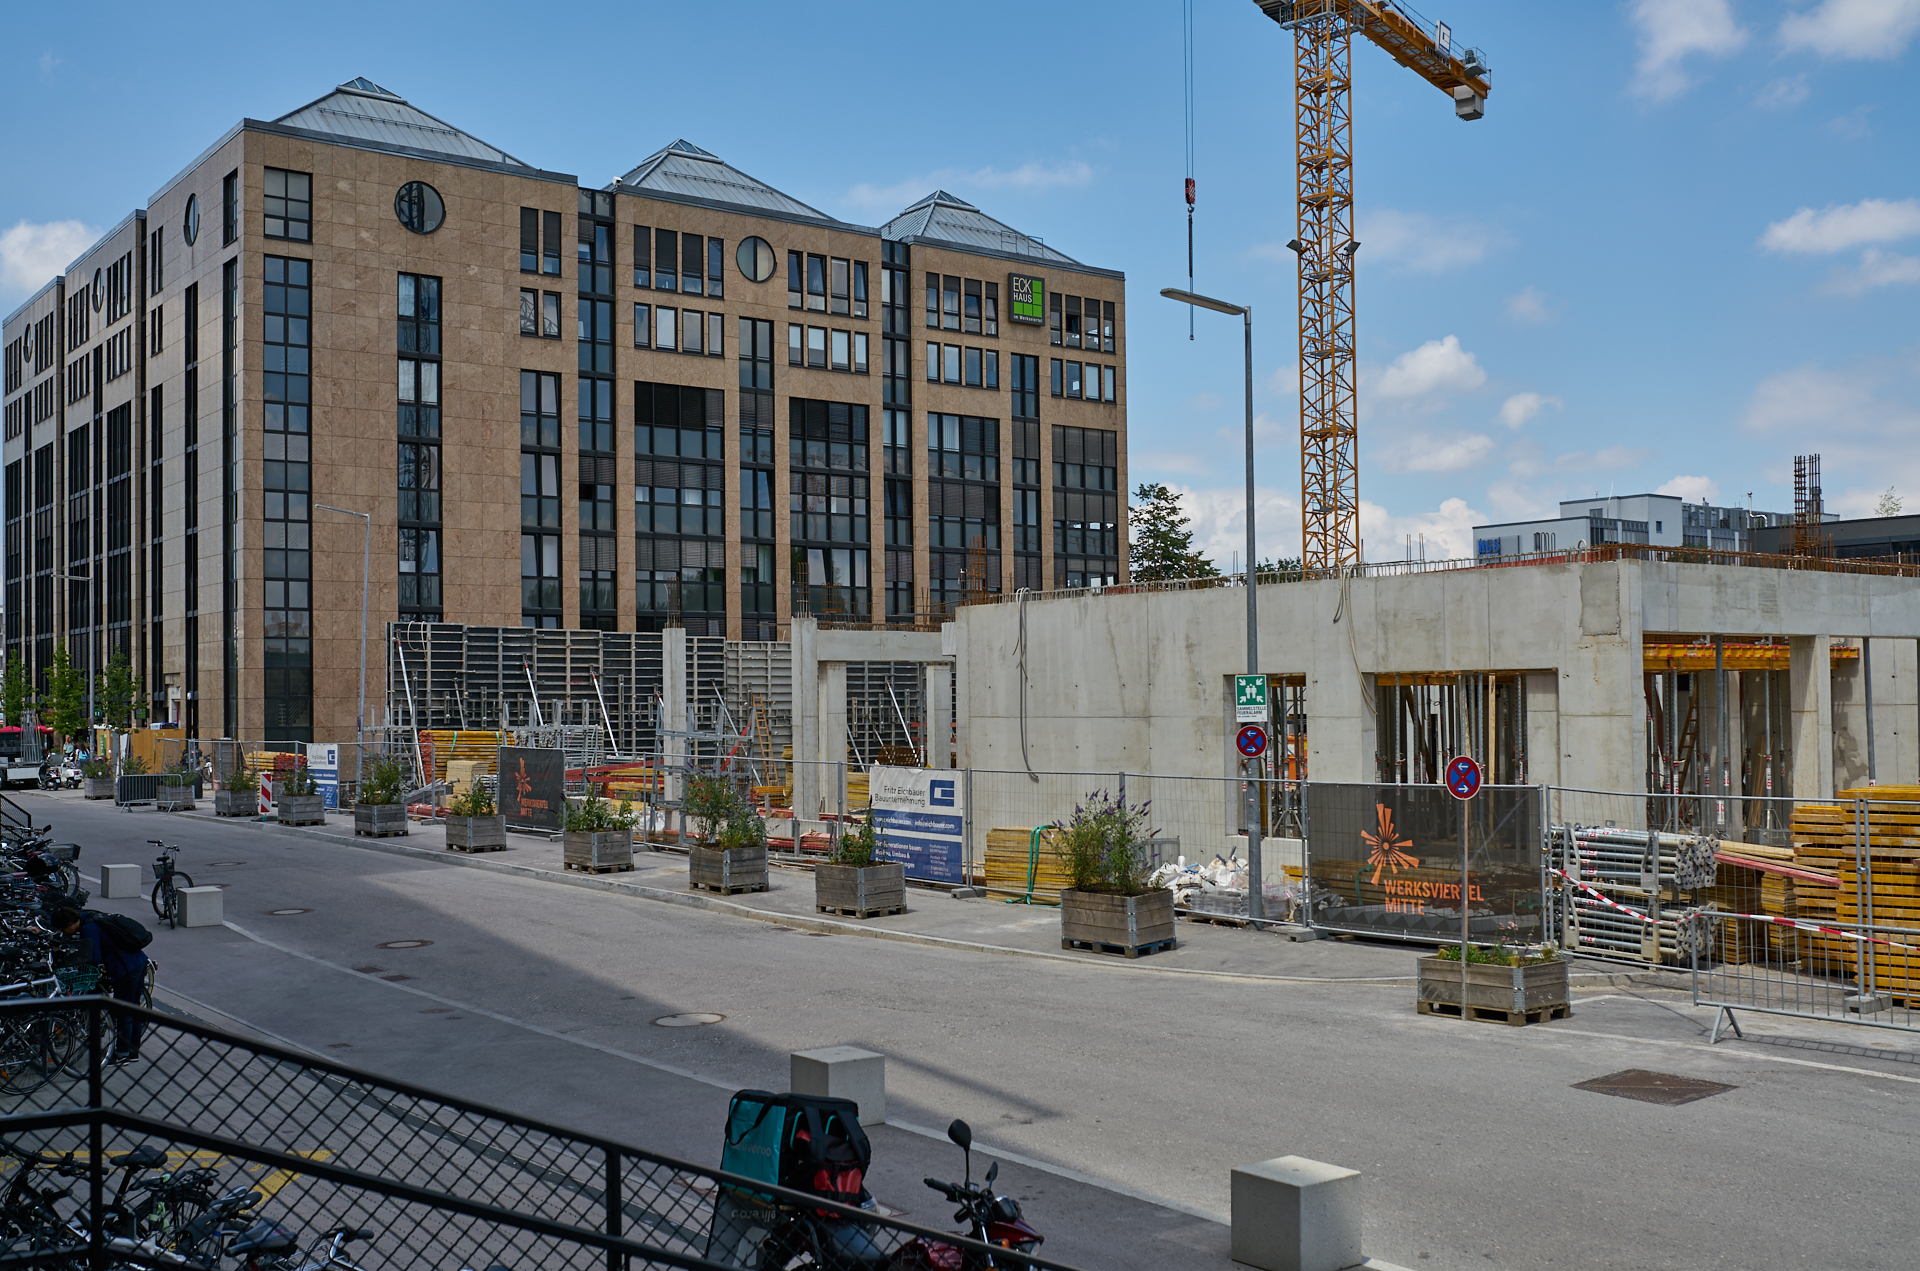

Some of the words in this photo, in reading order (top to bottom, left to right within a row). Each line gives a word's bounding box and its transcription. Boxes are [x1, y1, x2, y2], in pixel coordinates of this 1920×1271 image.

[1013, 276, 1032, 294] ECK
[1013, 292, 1033, 303] HAUS
[883, 785, 897, 795] Fritz
[897, 786, 926, 797] Eichbauer
[874, 793, 926, 808] Bauunternehmung
[1383, 879, 1485, 902] WERKSVIEREL
[1384, 896, 1425, 916] MITTE
